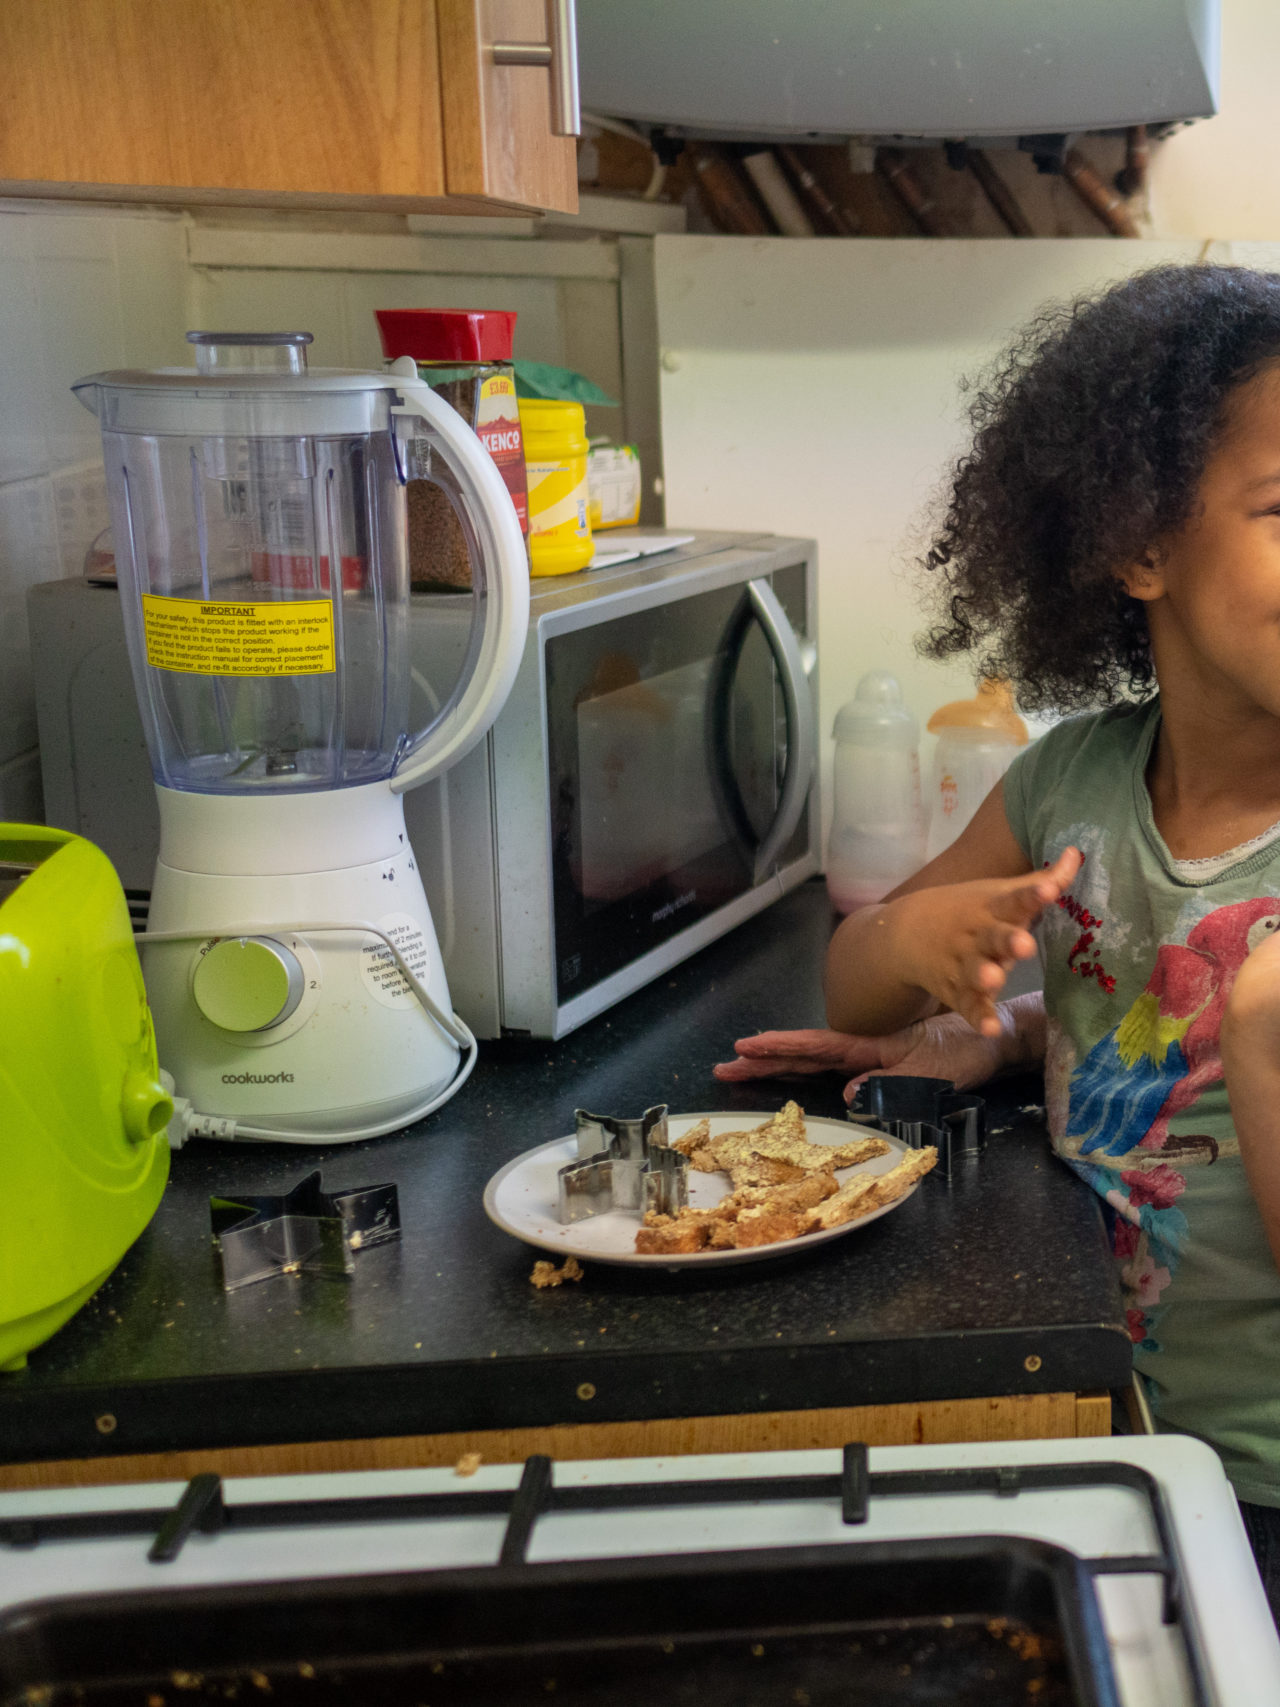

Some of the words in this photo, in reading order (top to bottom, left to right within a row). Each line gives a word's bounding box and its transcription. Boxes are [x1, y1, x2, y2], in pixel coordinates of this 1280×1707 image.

[482, 431, 520, 452] KENCO
[201, 606, 256, 615] IMPORTANT
[147, 620, 178, 630] mechanism
[207, 618, 235, 627] product
[148, 630, 171, 638] container
[176, 652, 210, 661] instruction
[284, 654, 323, 663] placement
[232, 665, 276, 673] accordingly
[200, 937, 220, 955] Pulse
[362, 944, 389, 953] maxim
[378, 950, 393, 960] furth
[367, 960, 394, 973] required
[382, 970, 398, 980] room
[310, 980, 316, 989] 2
[382, 979, 401, 990] before
